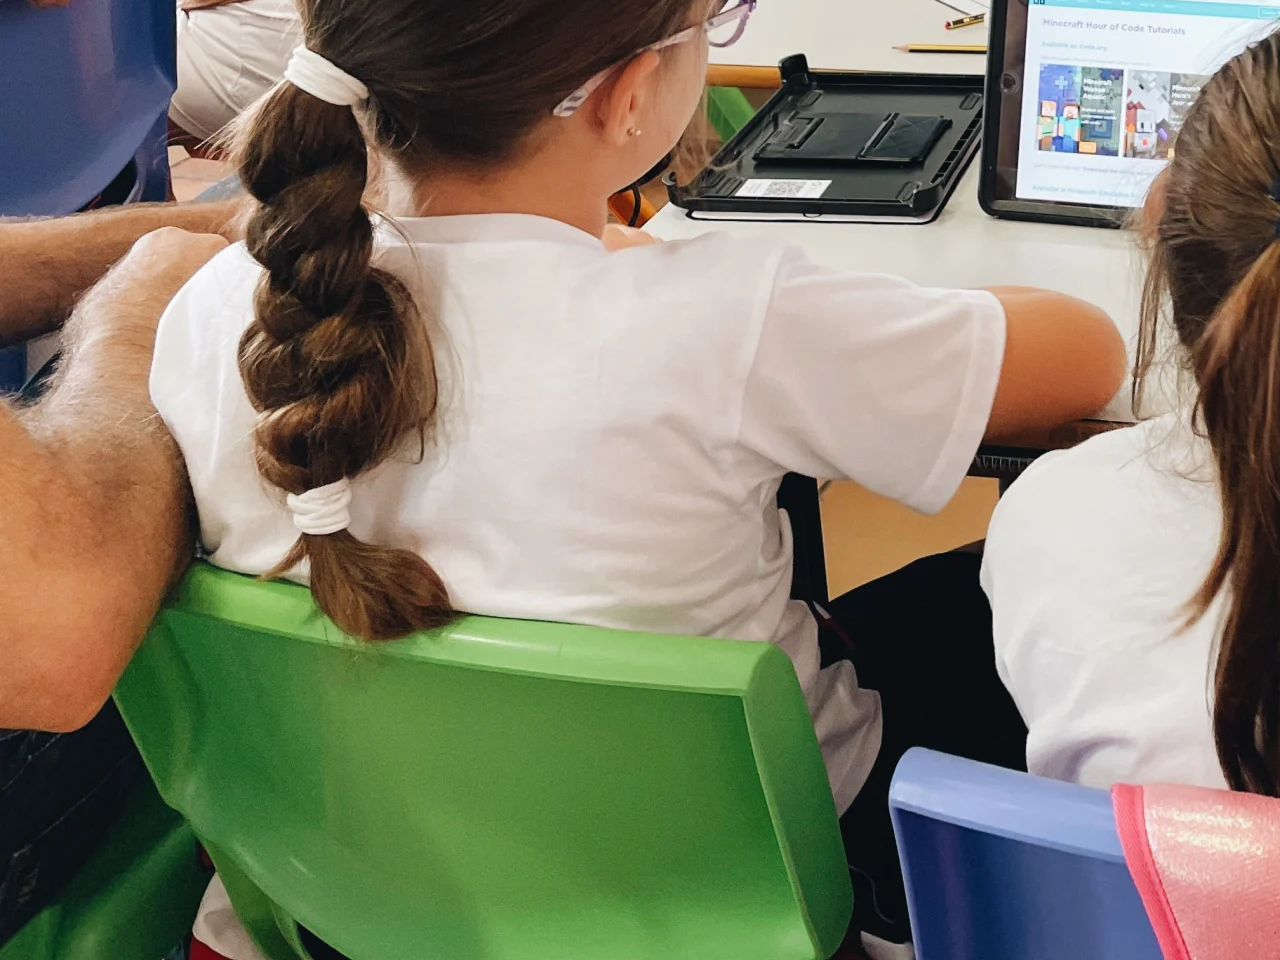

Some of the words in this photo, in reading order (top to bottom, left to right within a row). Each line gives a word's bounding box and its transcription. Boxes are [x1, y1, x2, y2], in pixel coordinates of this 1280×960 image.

[1043, 18, 1084, 29] Minecraft
[1086, 21, 1107, 30] Hour
[1110, 22, 1120, 31] of
[1121, 23, 1145, 32] Code
[1147, 25, 1186, 35] Tutorials
[1080, 43, 1107, 52] Code.org
